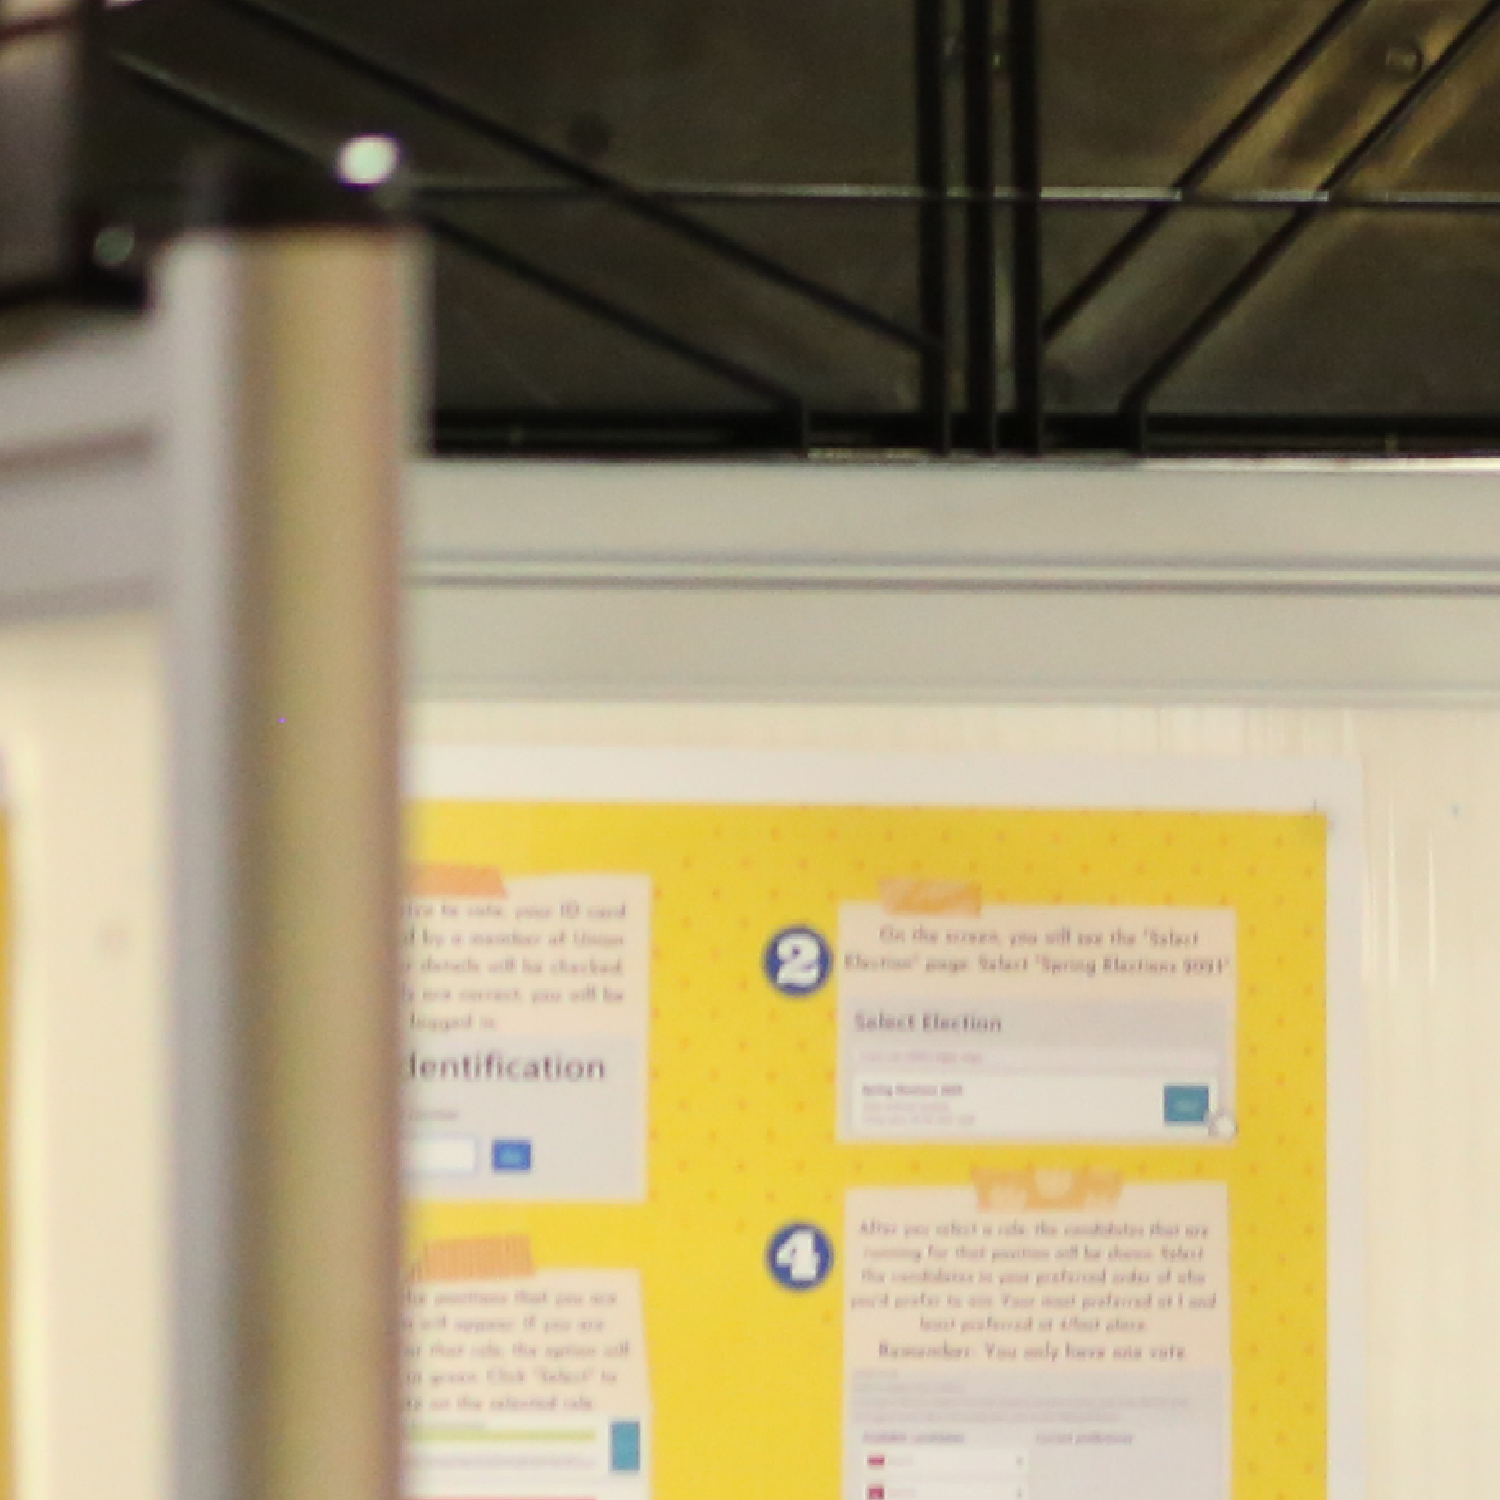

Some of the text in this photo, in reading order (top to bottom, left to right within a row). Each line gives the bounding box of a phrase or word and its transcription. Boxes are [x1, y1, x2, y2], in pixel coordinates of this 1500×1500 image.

[775, 934, 820, 987] 2
[855, 1008, 1002, 1033] Select Election
[775, 1229, 821, 1283] 4
